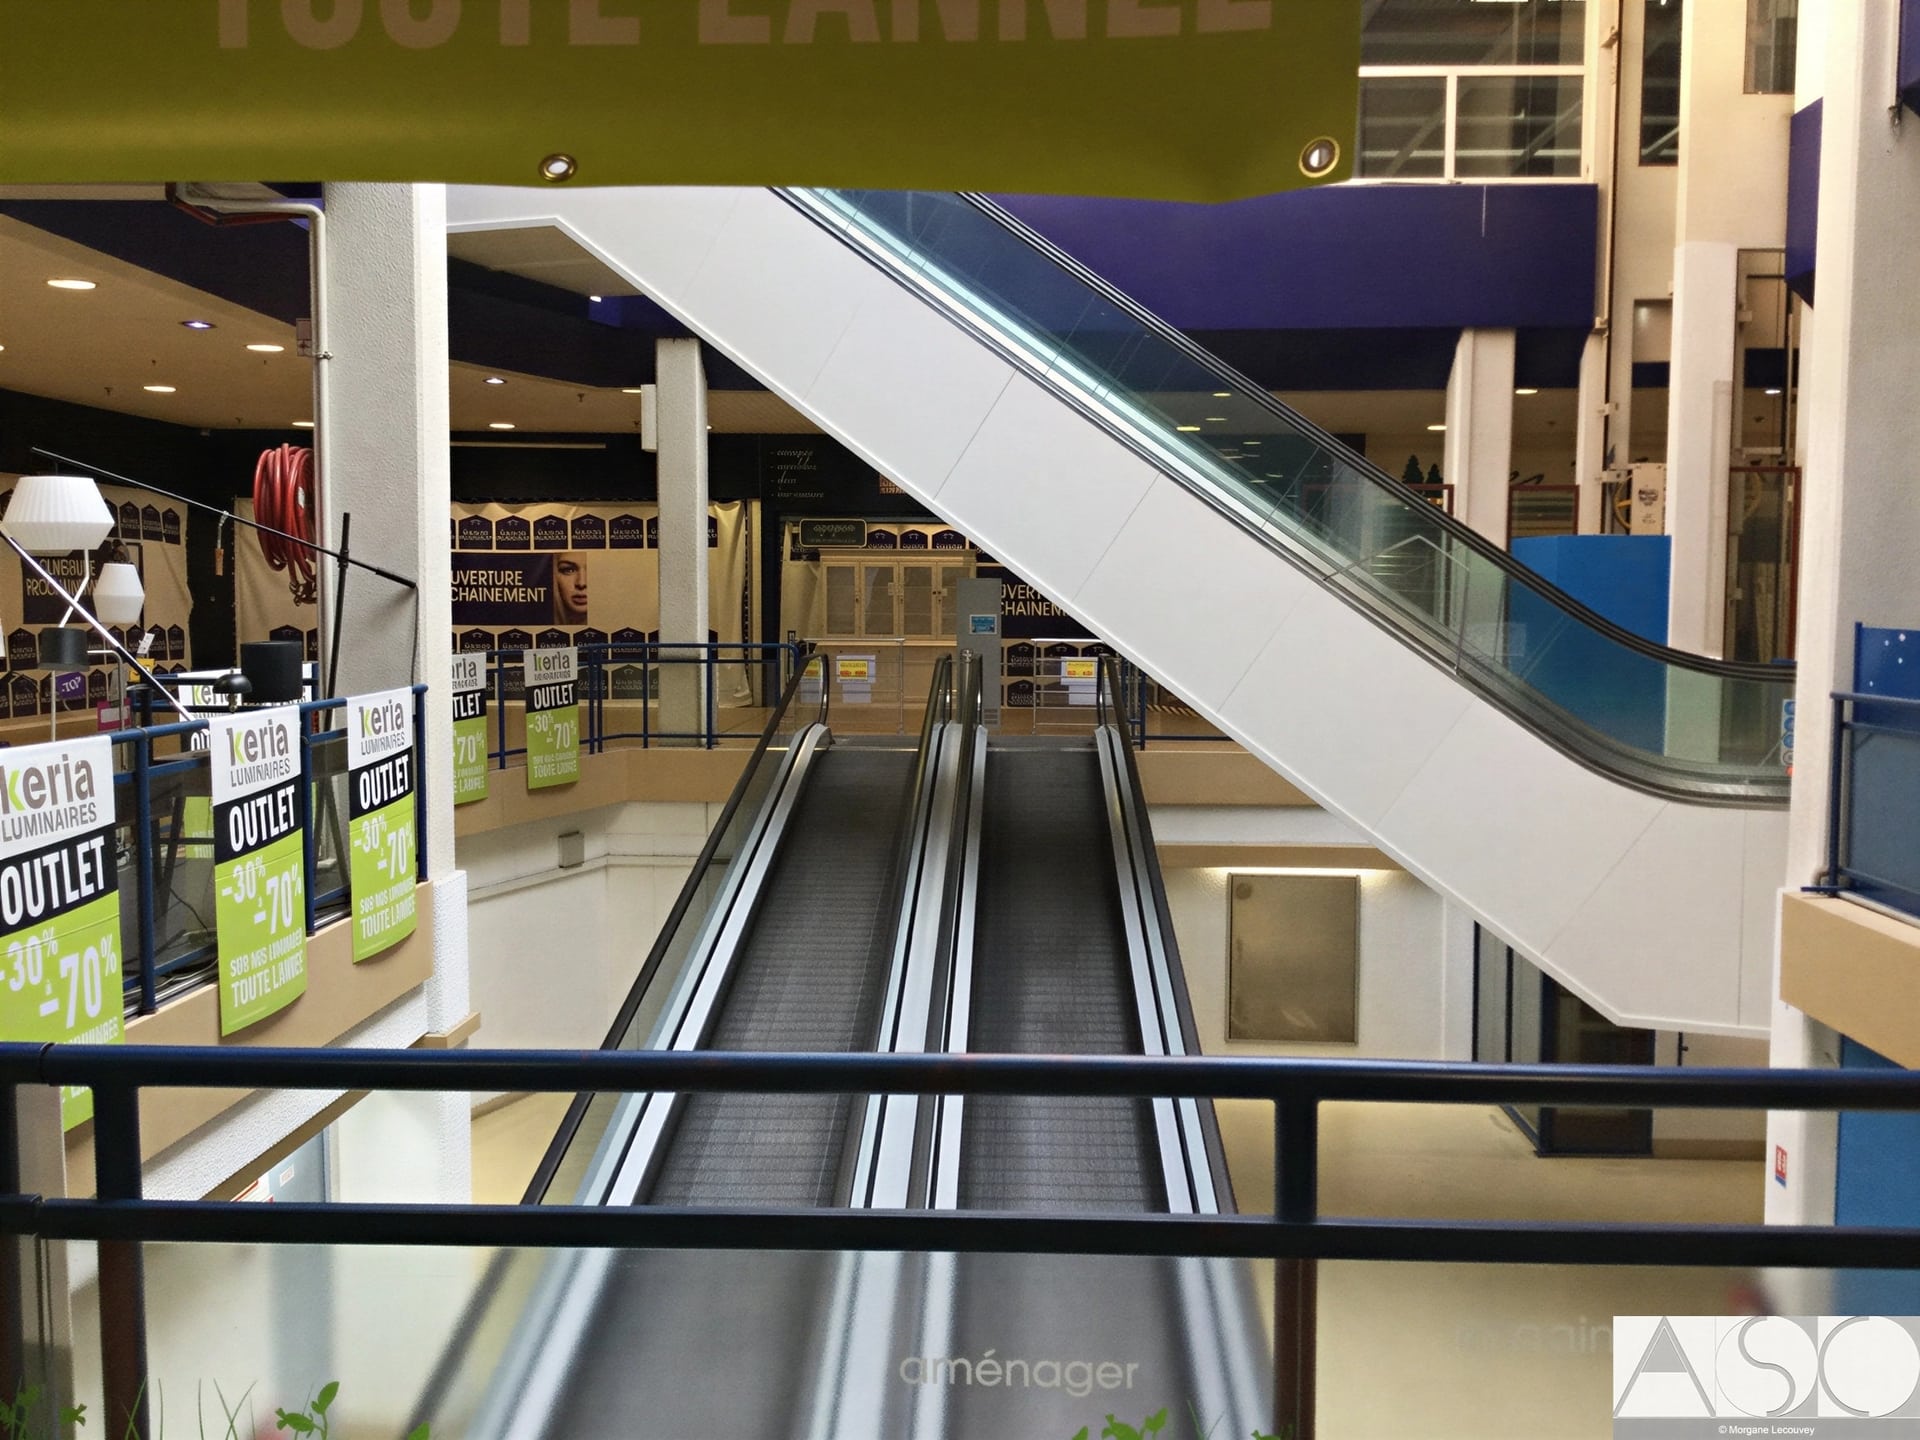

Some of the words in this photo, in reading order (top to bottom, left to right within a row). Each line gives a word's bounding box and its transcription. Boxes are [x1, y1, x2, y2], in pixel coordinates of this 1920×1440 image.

[451, 570, 523, 585] UVERTURE
[359, 699, 404, 738] keria
[453, 693, 481, 718] TLET
[534, 684, 574, 710] OUTLET
[226, 719, 289, 766] keria
[0, 753, 94, 815] keria
[230, 757, 291, 788] LUMINAIRES
[359, 754, 408, 810] OUTLET
[2, 802, 97, 842] LUMINAIRES
[229, 784, 295, 852] OUTLET
[0, 835, 105, 926] OUTLET
[221, 855, 266, 903] -30%
[254, 862, 302, 935] -70%
[0, 926, 58, 992] -30%
[39, 932, 117, 1030] -70%
[231, 967, 270, 1009] TOUTE
[900, 1349, 1139, 1397] aménager
